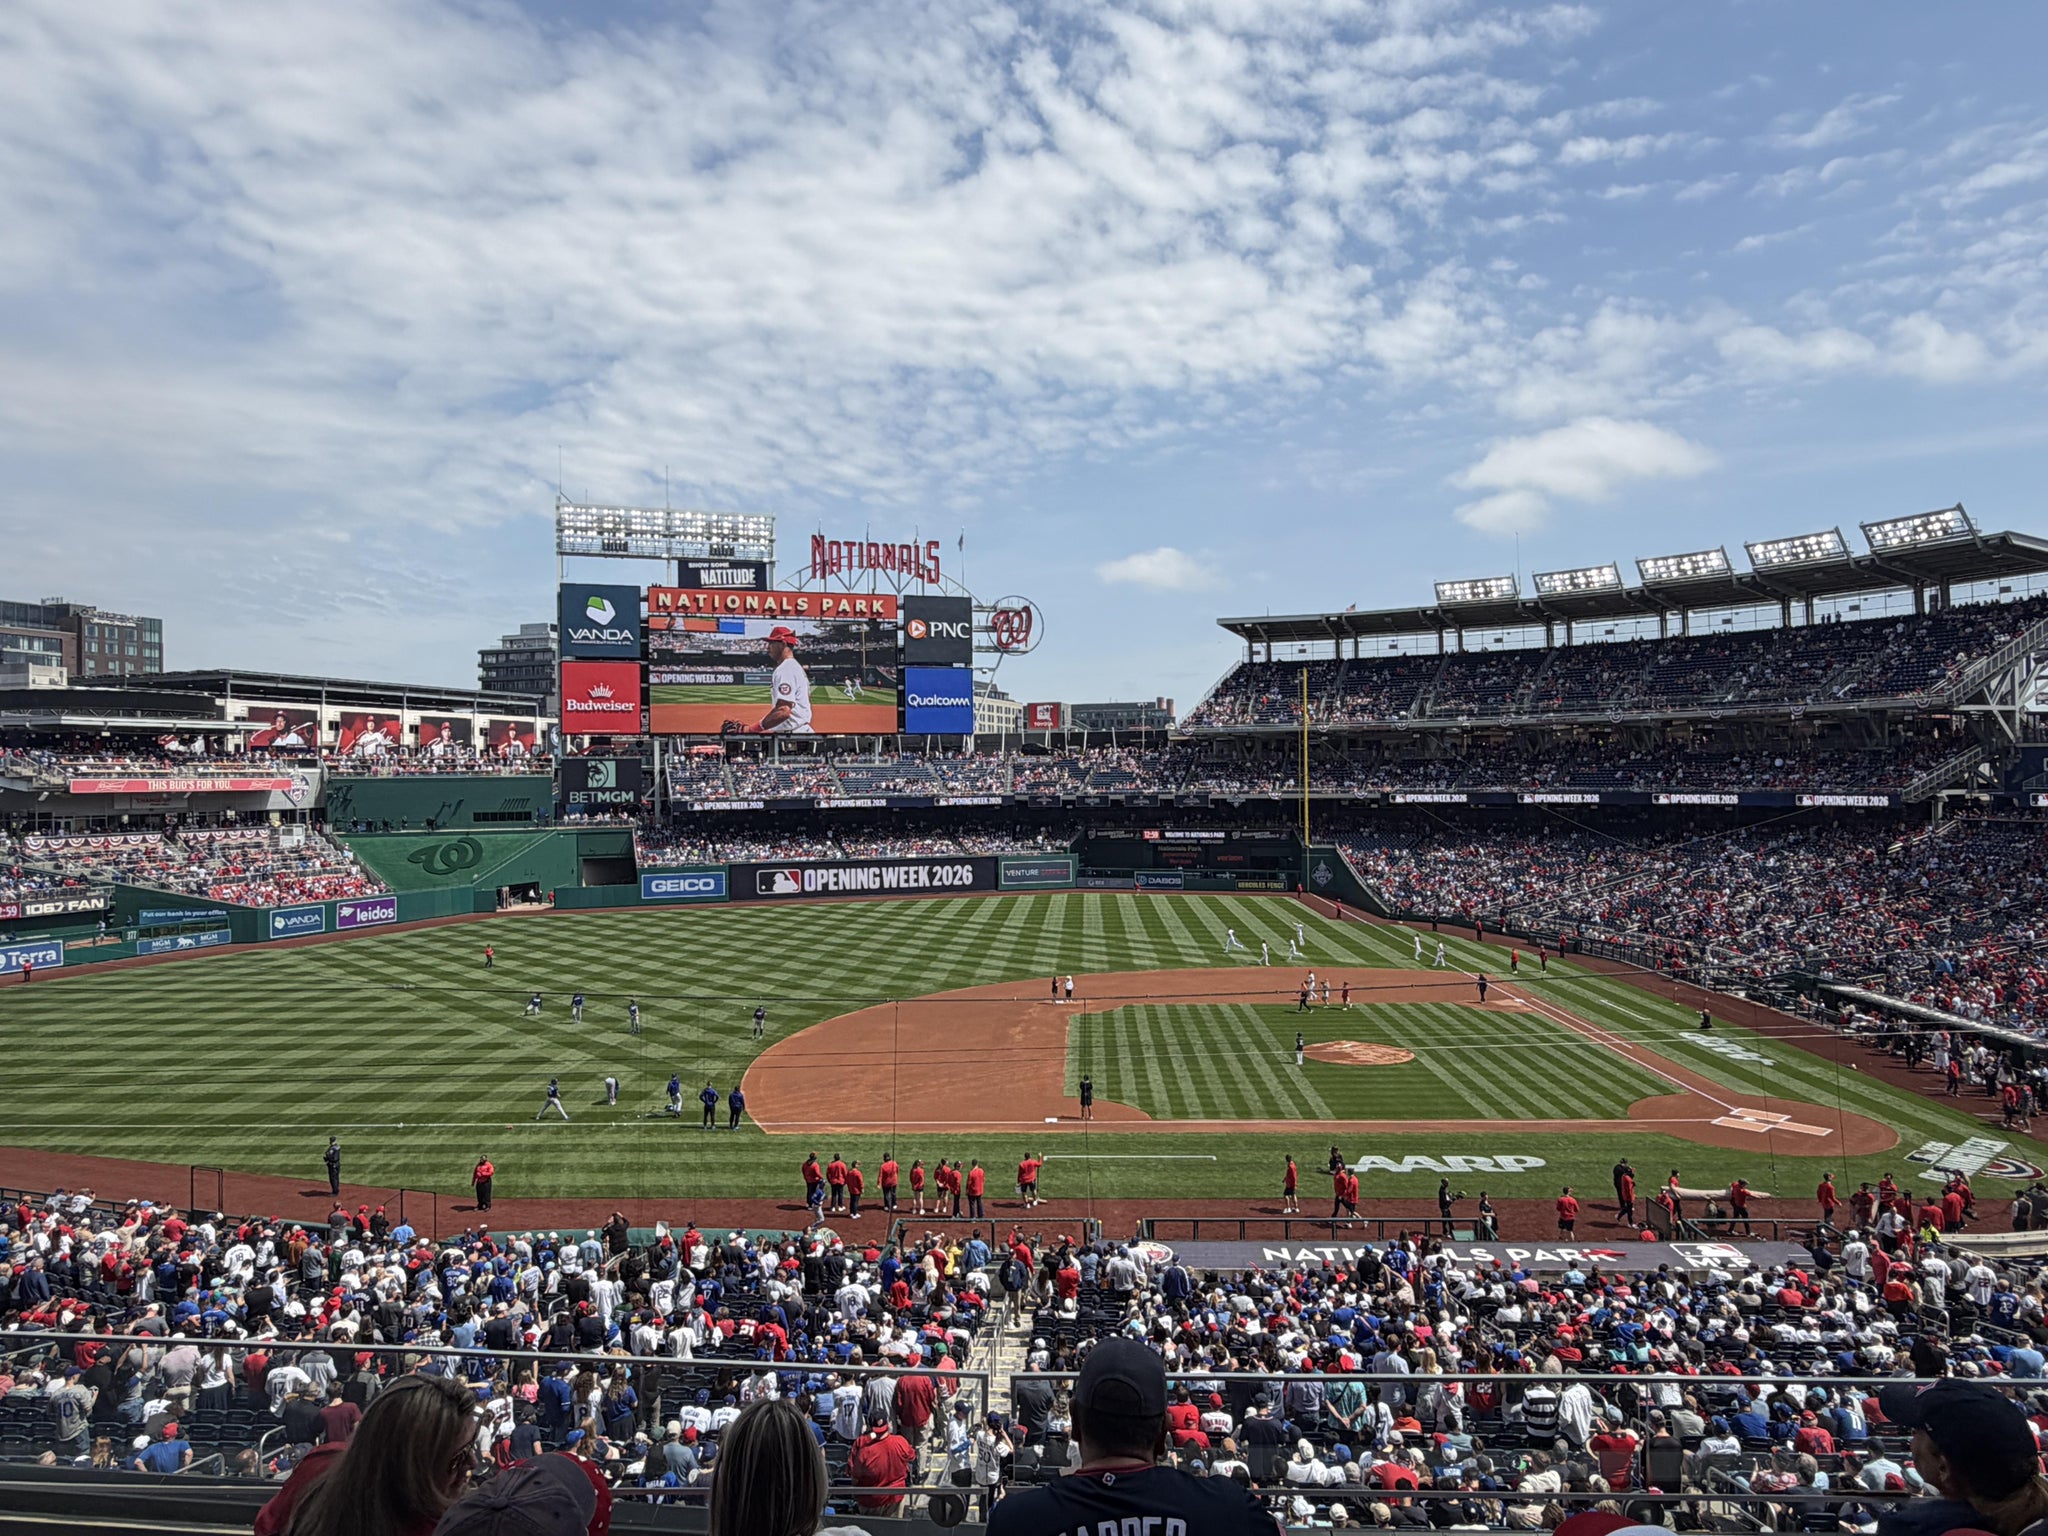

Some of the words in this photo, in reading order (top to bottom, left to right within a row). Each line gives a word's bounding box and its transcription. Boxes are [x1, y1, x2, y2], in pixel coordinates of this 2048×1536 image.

[811, 534, 940, 584] NATIONALS
[701, 568, 756, 585] NATITUDE
[658, 592, 809, 611] NATIONALS
[822, 598, 885, 613] PARK
[568, 628, 634, 641] VANDA
[929, 621, 970, 639] PNC
[661, 673, 695, 683] OPENING
[695, 673, 716, 683] WEEK
[716, 674, 734, 683] 2026
[566, 699, 636, 711] Budweiser
[908, 693, 970, 707] Qualcomm
[148, 780, 168, 790] THIS
[169, 780, 194, 790] BUD'S
[196, 780, 213, 790] FOR
[214, 780, 232, 790] YOU.
[569, 790, 634, 803] BETMGM
[1671, 794, 1700, 804] OPENING
[1700, 794, 1720, 804] WEEK
[1721, 795, 1738, 804] 2026
[1814, 795, 1846, 805] OPENING
[1846, 795, 1868, 806] WEEK
[1869, 796, 1889, 806] 2026
[803, 867, 881, 893] OPENING
[881, 865, 931, 890] WEEK
[932, 864, 973, 887] 2026
[1005, 869, 1040, 877] VENTURE
[651, 877, 715, 893] GEICO
[68, 898, 104, 911] FAN
[192, 910, 207, 918] your
[285, 914, 320, 925] VANDA
[356, 905, 395, 922] leidos
[152, 939, 171, 947] MGM
[200, 933, 218, 941] MGM
[8, 949, 57, 966] Terra
[1353, 1155, 1547, 1173] AARP
[739, 1324, 755, 1337] 21
[467, 1360, 479, 1375] 17
[843, 1402, 855, 1418] 17
[1851, 1412, 1863, 1431] 11
